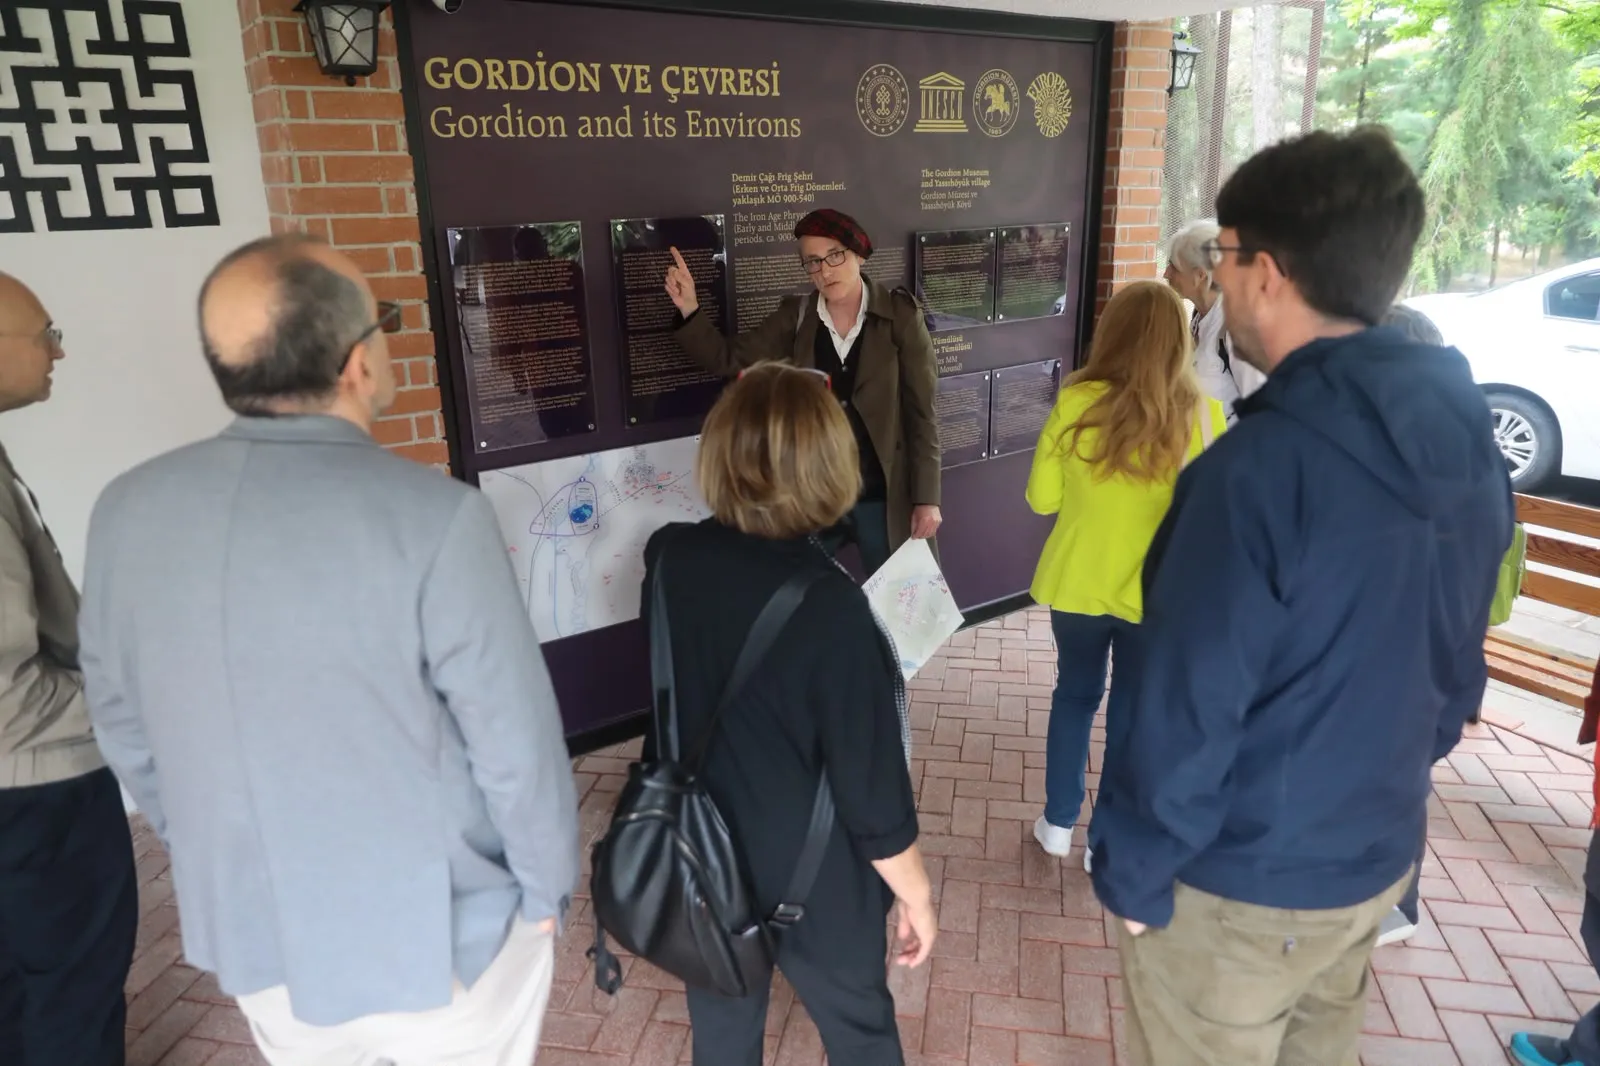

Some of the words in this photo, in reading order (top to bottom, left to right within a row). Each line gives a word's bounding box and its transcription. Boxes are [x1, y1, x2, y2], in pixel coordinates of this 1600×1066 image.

[424, 51, 601, 93] GORDİON
[610, 63, 652, 94] VE
[661, 61, 781, 103] ÇEVRESİ
[1026, 71, 1072, 109] EUROPEAN
[921, 89, 963, 120] UNESCO
[430, 103, 568, 138] Gordion
[577, 105, 634, 138] and
[643, 110, 677, 138] its
[685, 110, 802, 138] Environs
[731, 172, 757, 183] Demir
[758, 172, 776, 184] Çağı
[777, 172, 792, 183] Frig
[794, 171, 814, 183] Şehri
[921, 168, 934, 178] The
[935, 168, 962, 178] Gordion
[963, 168, 990, 177] Museum
[732, 184, 758, 194] (Erken
[760, 185, 769, 193] ve
[771, 183, 788, 193] Orta
[790, 182, 805, 194] Frig
[921, 179, 934, 188] and
[971, 178, 991, 188] village
[732, 195, 765, 207] yaklaşık
[767, 192, 782, 204] MÖ
[783, 193, 815, 204] 900-540)
[920, 190, 947, 200] Gordion
[733, 212, 749, 222] The
[750, 212, 766, 222] Iron
[767, 212, 782, 224] Age
[734, 223, 756, 235] (Early
[757, 223, 772, 232] and
[773, 221, 796, 232] Middl
[946, 355, 958, 364] MM
